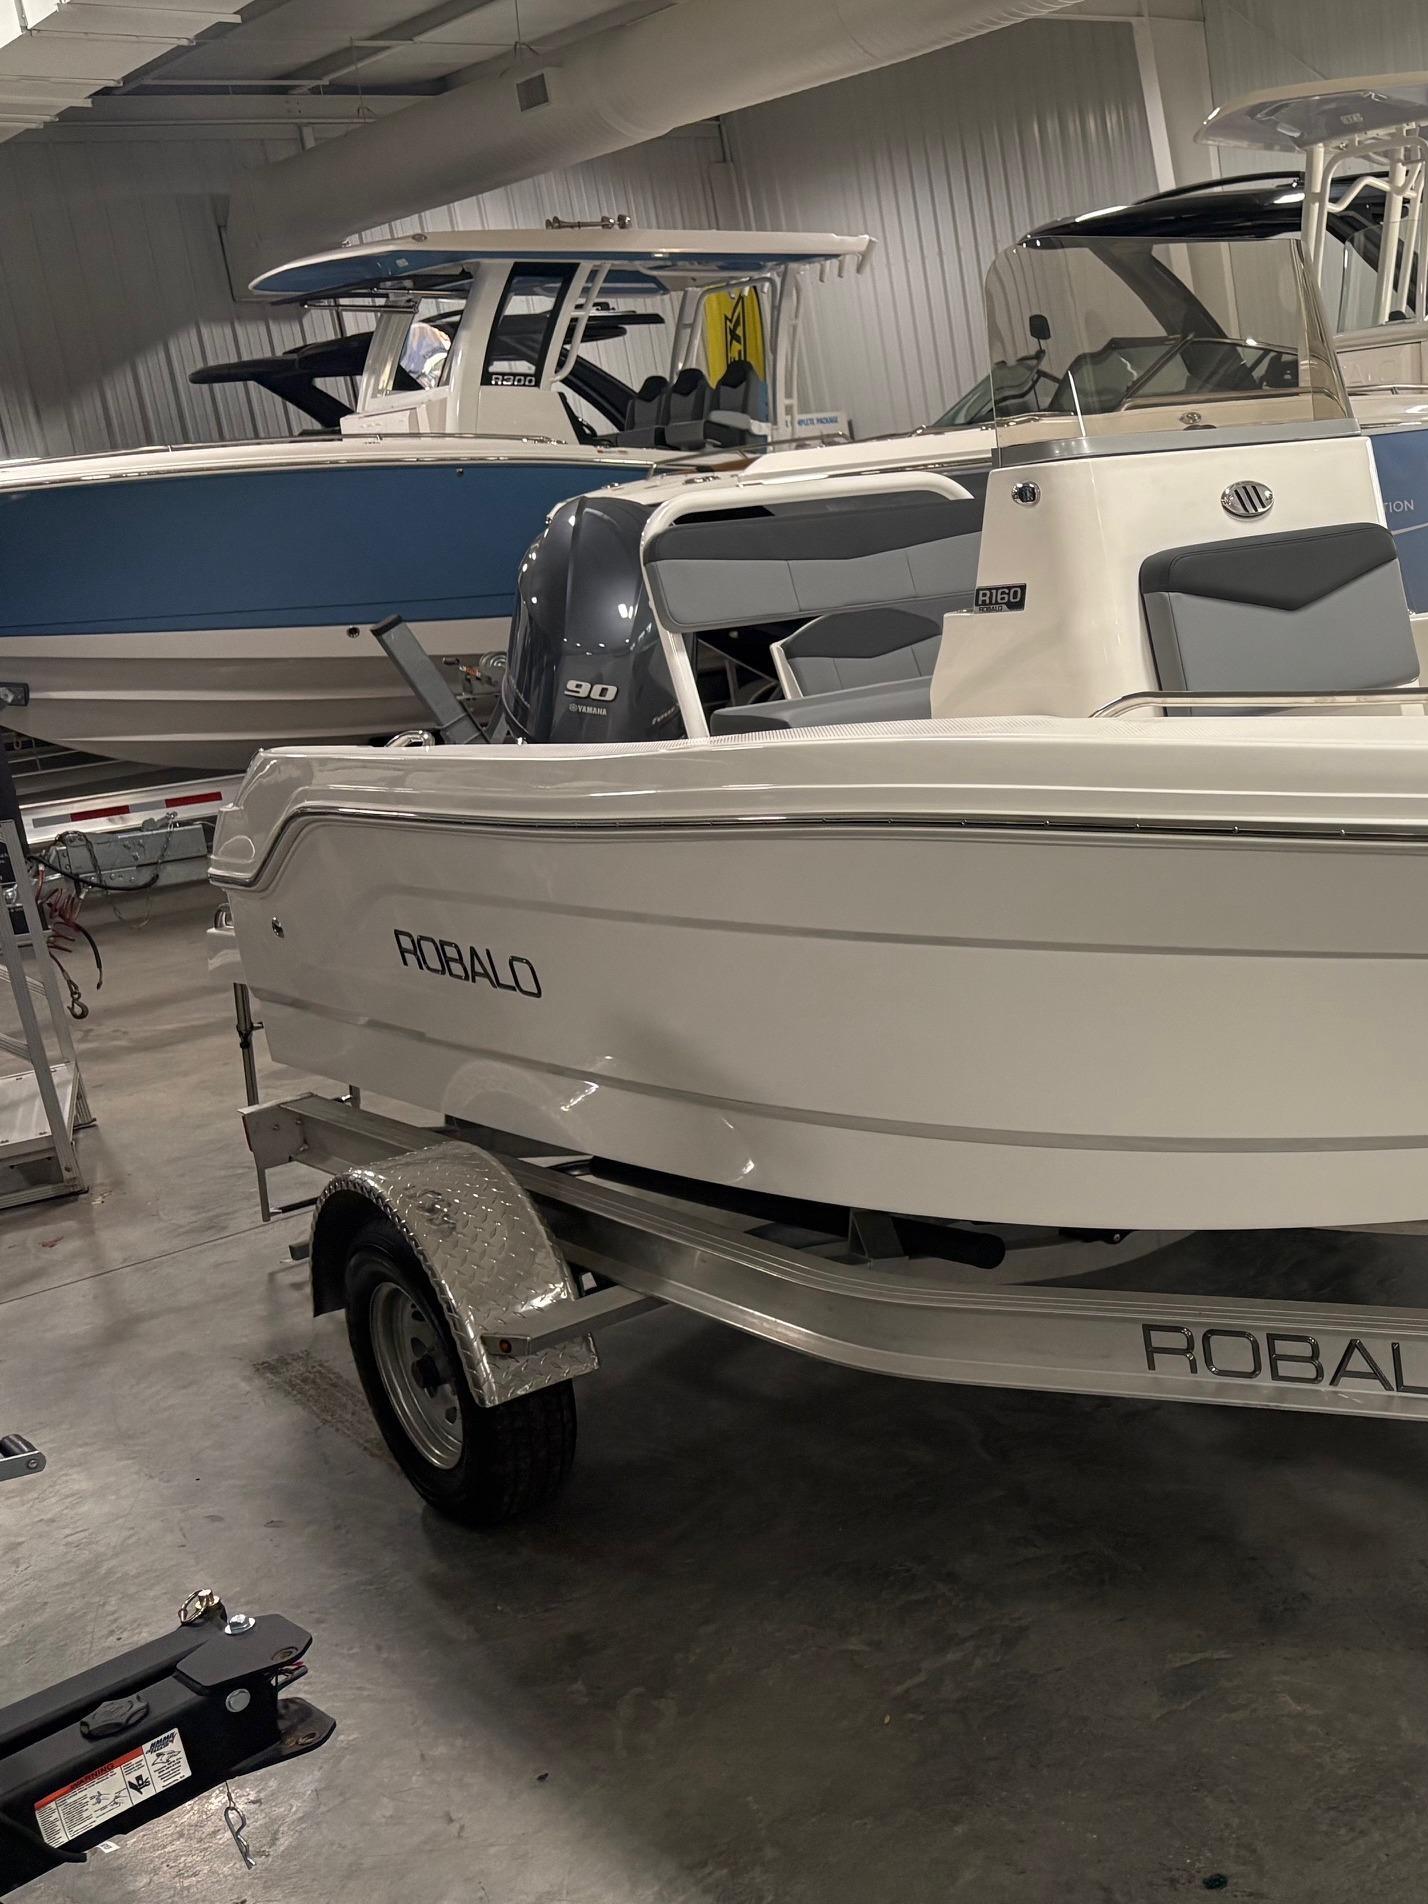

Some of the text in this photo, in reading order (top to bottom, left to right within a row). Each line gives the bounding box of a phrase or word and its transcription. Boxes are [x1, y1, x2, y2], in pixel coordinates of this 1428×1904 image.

[491, 374, 536, 386] R300
[978, 587, 1022, 605] R160
[564, 679, 619, 702] 90
[578, 704, 608, 716] YAMAHA
[393, 928, 542, 999] ROBALO
[70, 1762, 118, 1790] WARNING
